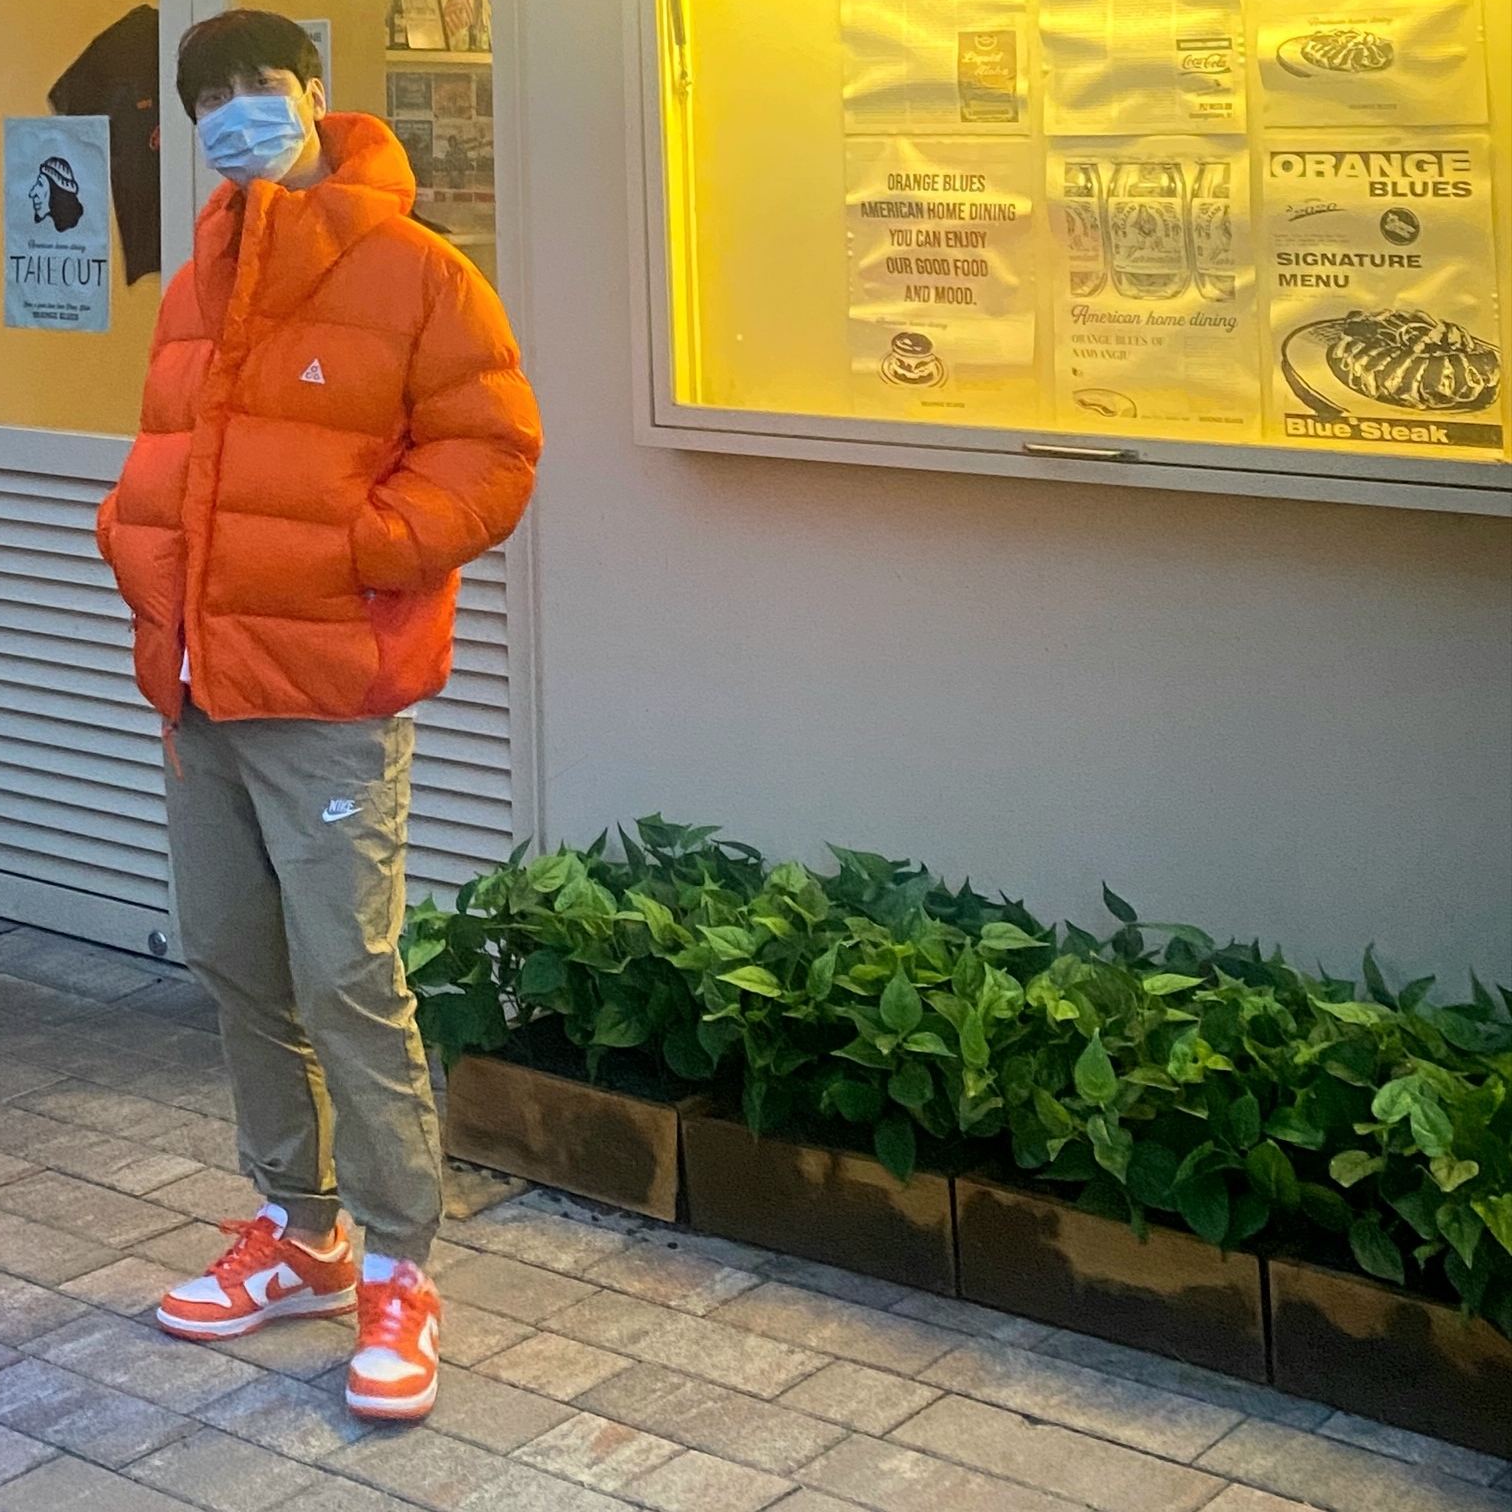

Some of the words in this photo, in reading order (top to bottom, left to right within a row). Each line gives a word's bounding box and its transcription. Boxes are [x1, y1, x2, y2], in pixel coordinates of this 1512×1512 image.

[1271, 151, 1472, 178] ORANGE
[887, 173, 939, 191] ORANGE
[943, 174, 986, 192] BLUES
[1369, 180, 1473, 198] BLUES
[861, 201, 924, 219] AMERICAN
[927, 202, 966, 220] HOME
[969, 203, 1016, 221] DINING
[889, 229, 913, 247] YOU
[916, 230, 942, 248] CAN
[945, 230, 987, 249] ENJOY
[886, 257, 913, 275] OUR
[915, 257, 950, 276] GOOD
[953, 259, 988, 277] FOOD
[1276, 252, 1423, 268] SIGNATURE
[1278, 273, 1350, 289] MENU
[904, 285, 931, 303] AND
[934, 286, 977, 305] MOOD.
[1070, 304, 1143, 325] American
[1145, 311, 1186, 326] home
[1189, 312, 1238, 333] dining
[1286, 417, 1352, 437] Blue
[1360, 420, 1449, 444] Steak
[328, 799, 356, 813] NIKE
